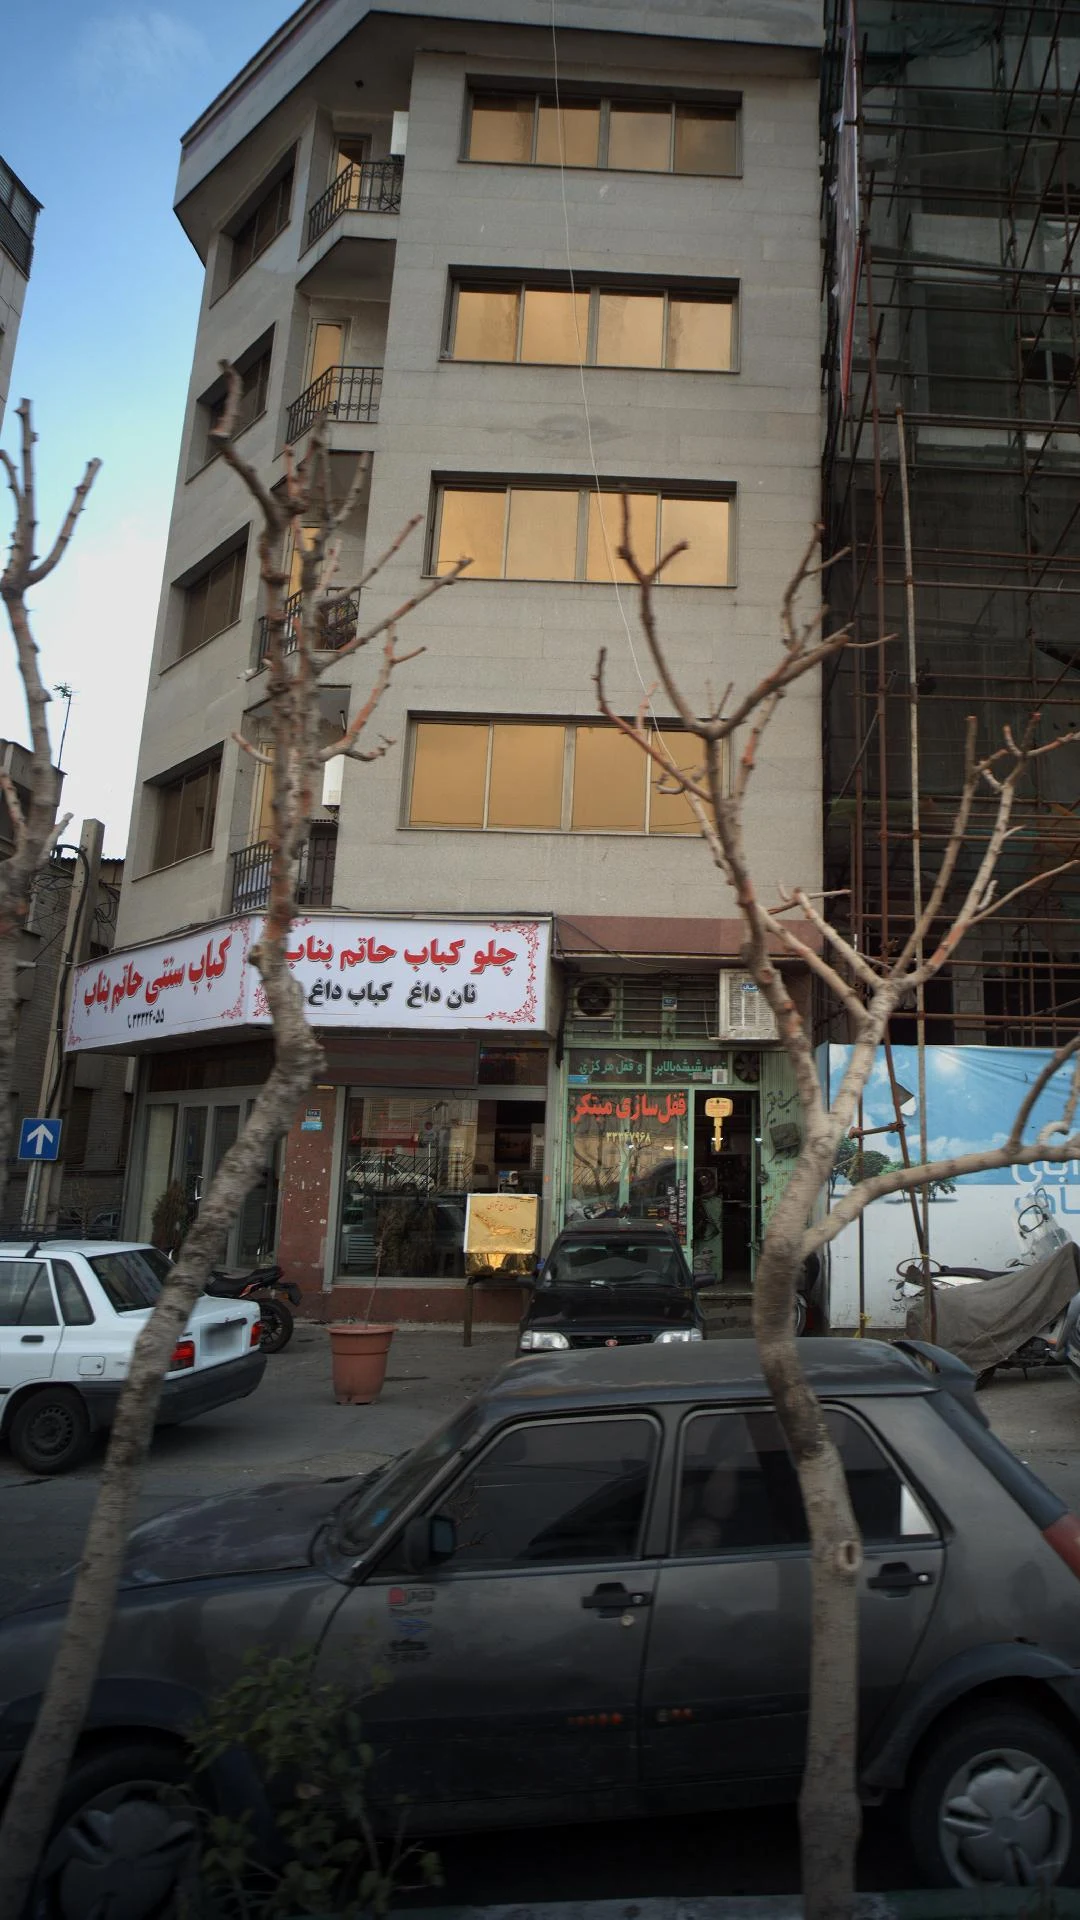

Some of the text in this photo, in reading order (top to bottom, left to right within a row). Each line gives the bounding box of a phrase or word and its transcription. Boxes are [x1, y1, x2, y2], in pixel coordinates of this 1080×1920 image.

[83, 933, 233, 1015] کباب سنتی حاتم بناب
[284, 935, 518, 976] چلو کباب حاتم بناب
[307, 977, 477, 1010] نان داغ کباب داغ
[571, 1092, 614, 1124] مبتکر
